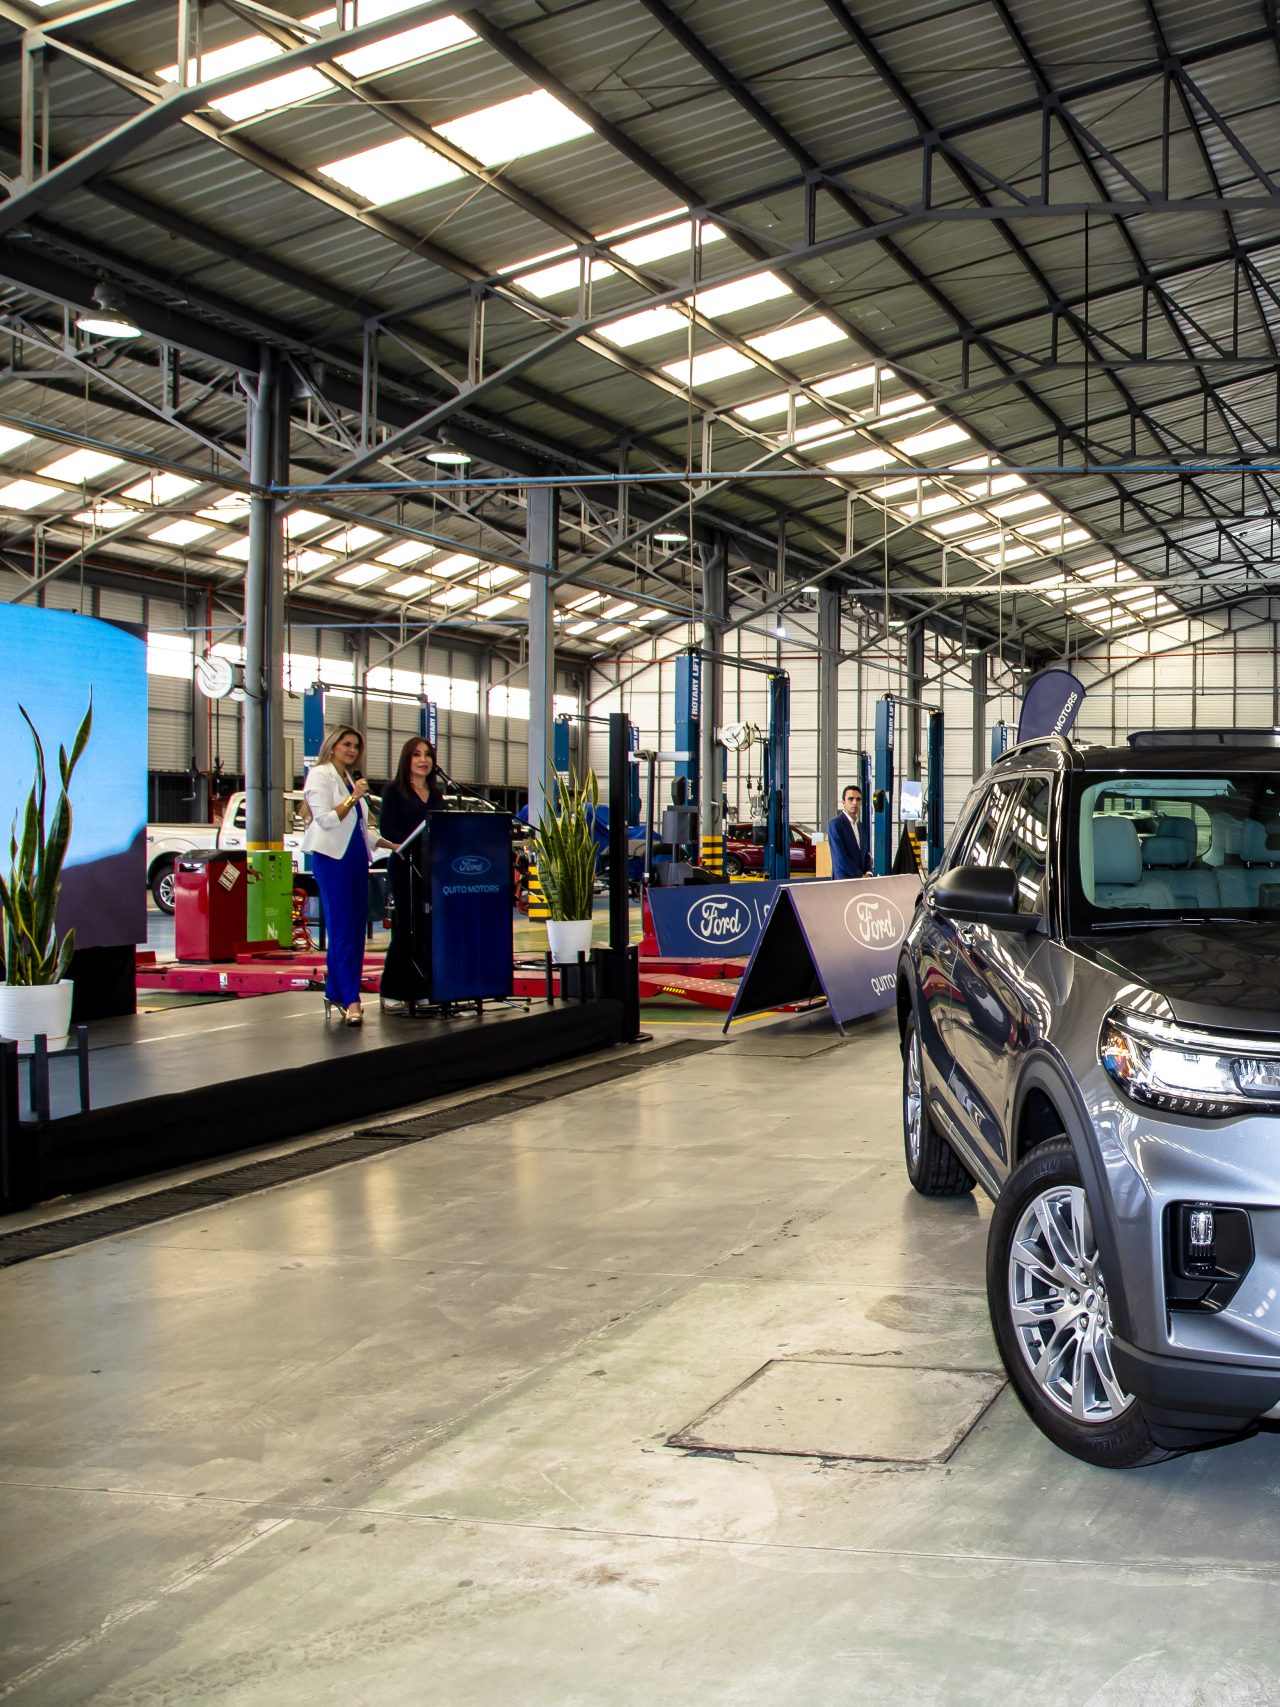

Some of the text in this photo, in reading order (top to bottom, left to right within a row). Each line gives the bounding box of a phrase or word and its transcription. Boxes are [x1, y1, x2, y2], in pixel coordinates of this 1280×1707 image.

[691, 656, 700, 715] ROTARY LIFT
[1055, 691, 1078, 733] MOTORS
[443, 884, 500, 896] QUITO MOTORS
[700, 901, 742, 937] Ford
[856, 901, 896, 942] Ford
[870, 972, 896, 996] QUITO
